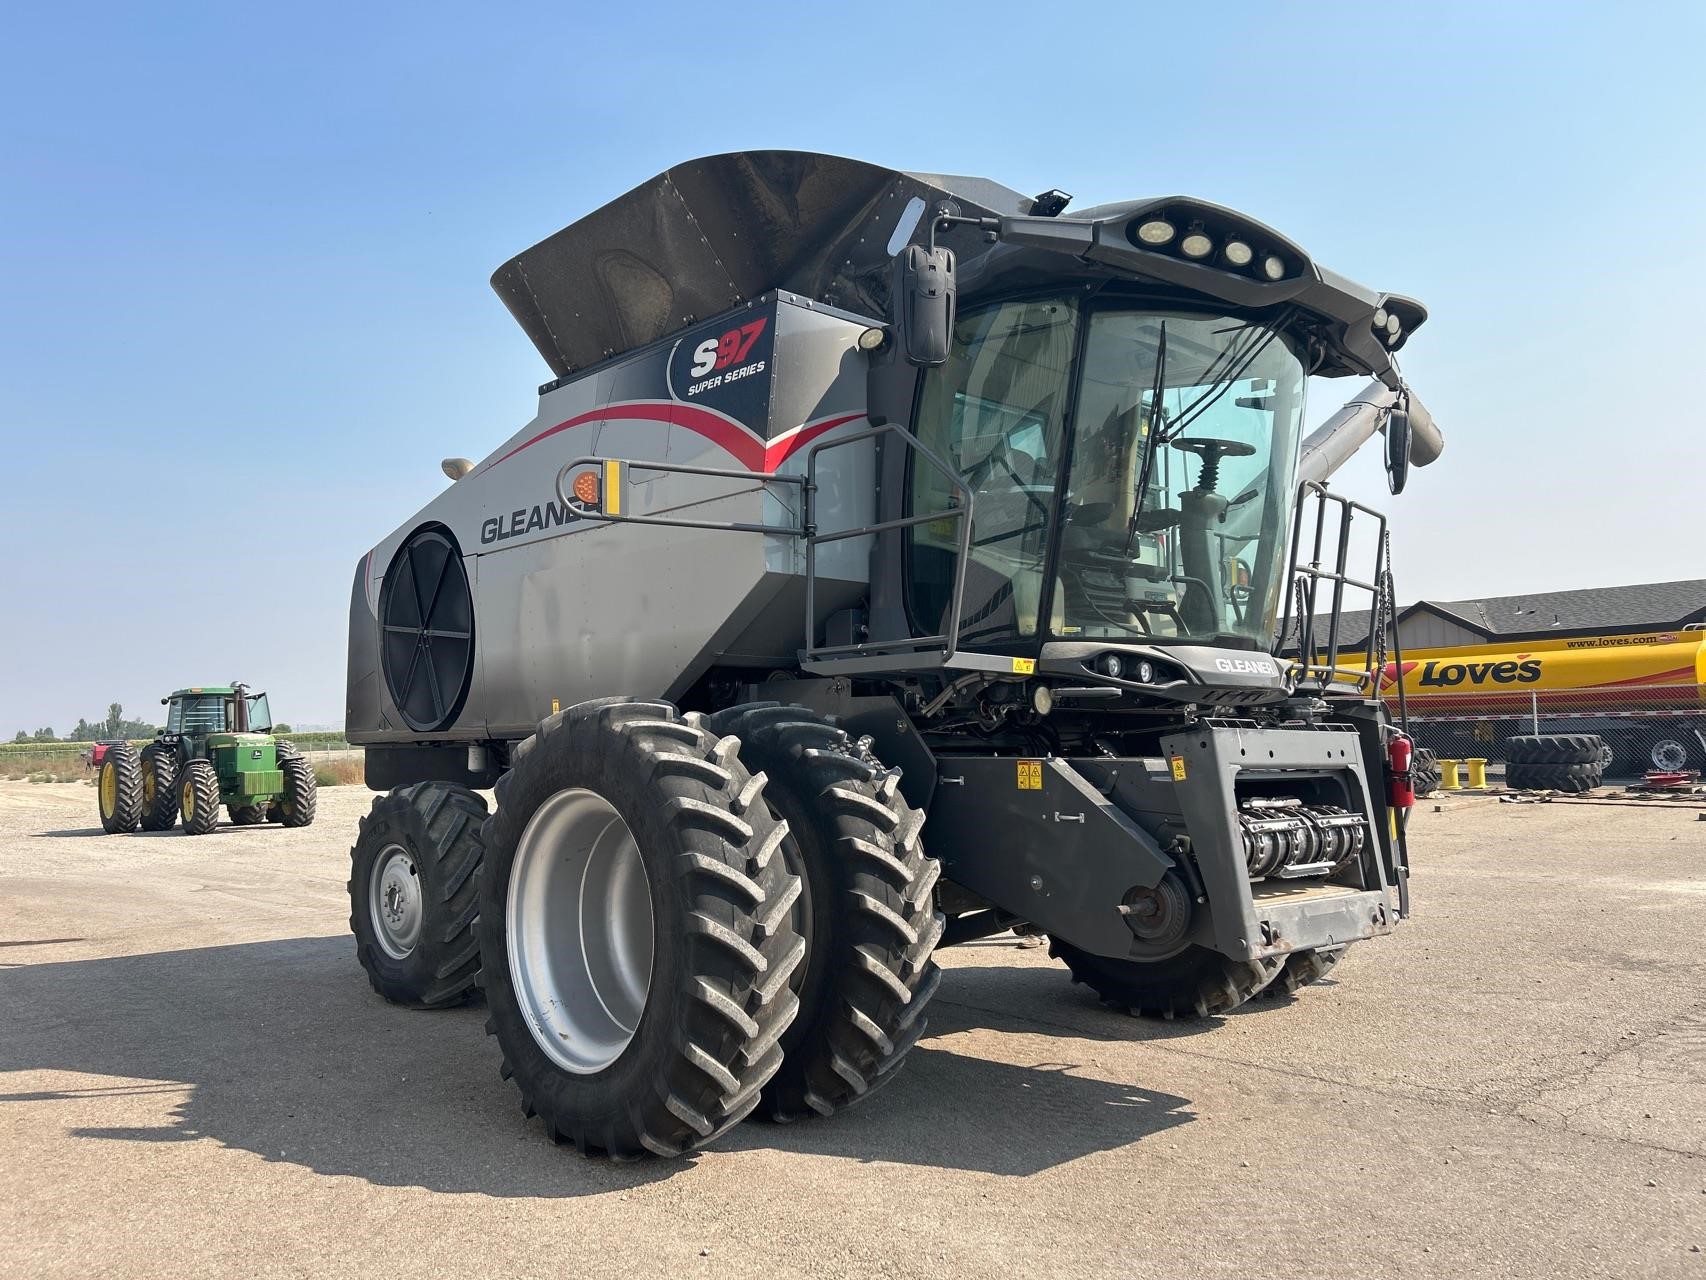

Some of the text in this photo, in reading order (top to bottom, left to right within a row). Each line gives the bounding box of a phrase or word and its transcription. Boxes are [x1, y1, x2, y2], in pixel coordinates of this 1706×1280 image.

[690, 317, 768, 378] S97
[688, 361, 766, 396] SUPER SERIES
[1566, 636, 1657, 649] www.loves.com
[1215, 658, 1275, 675] GLEANER
